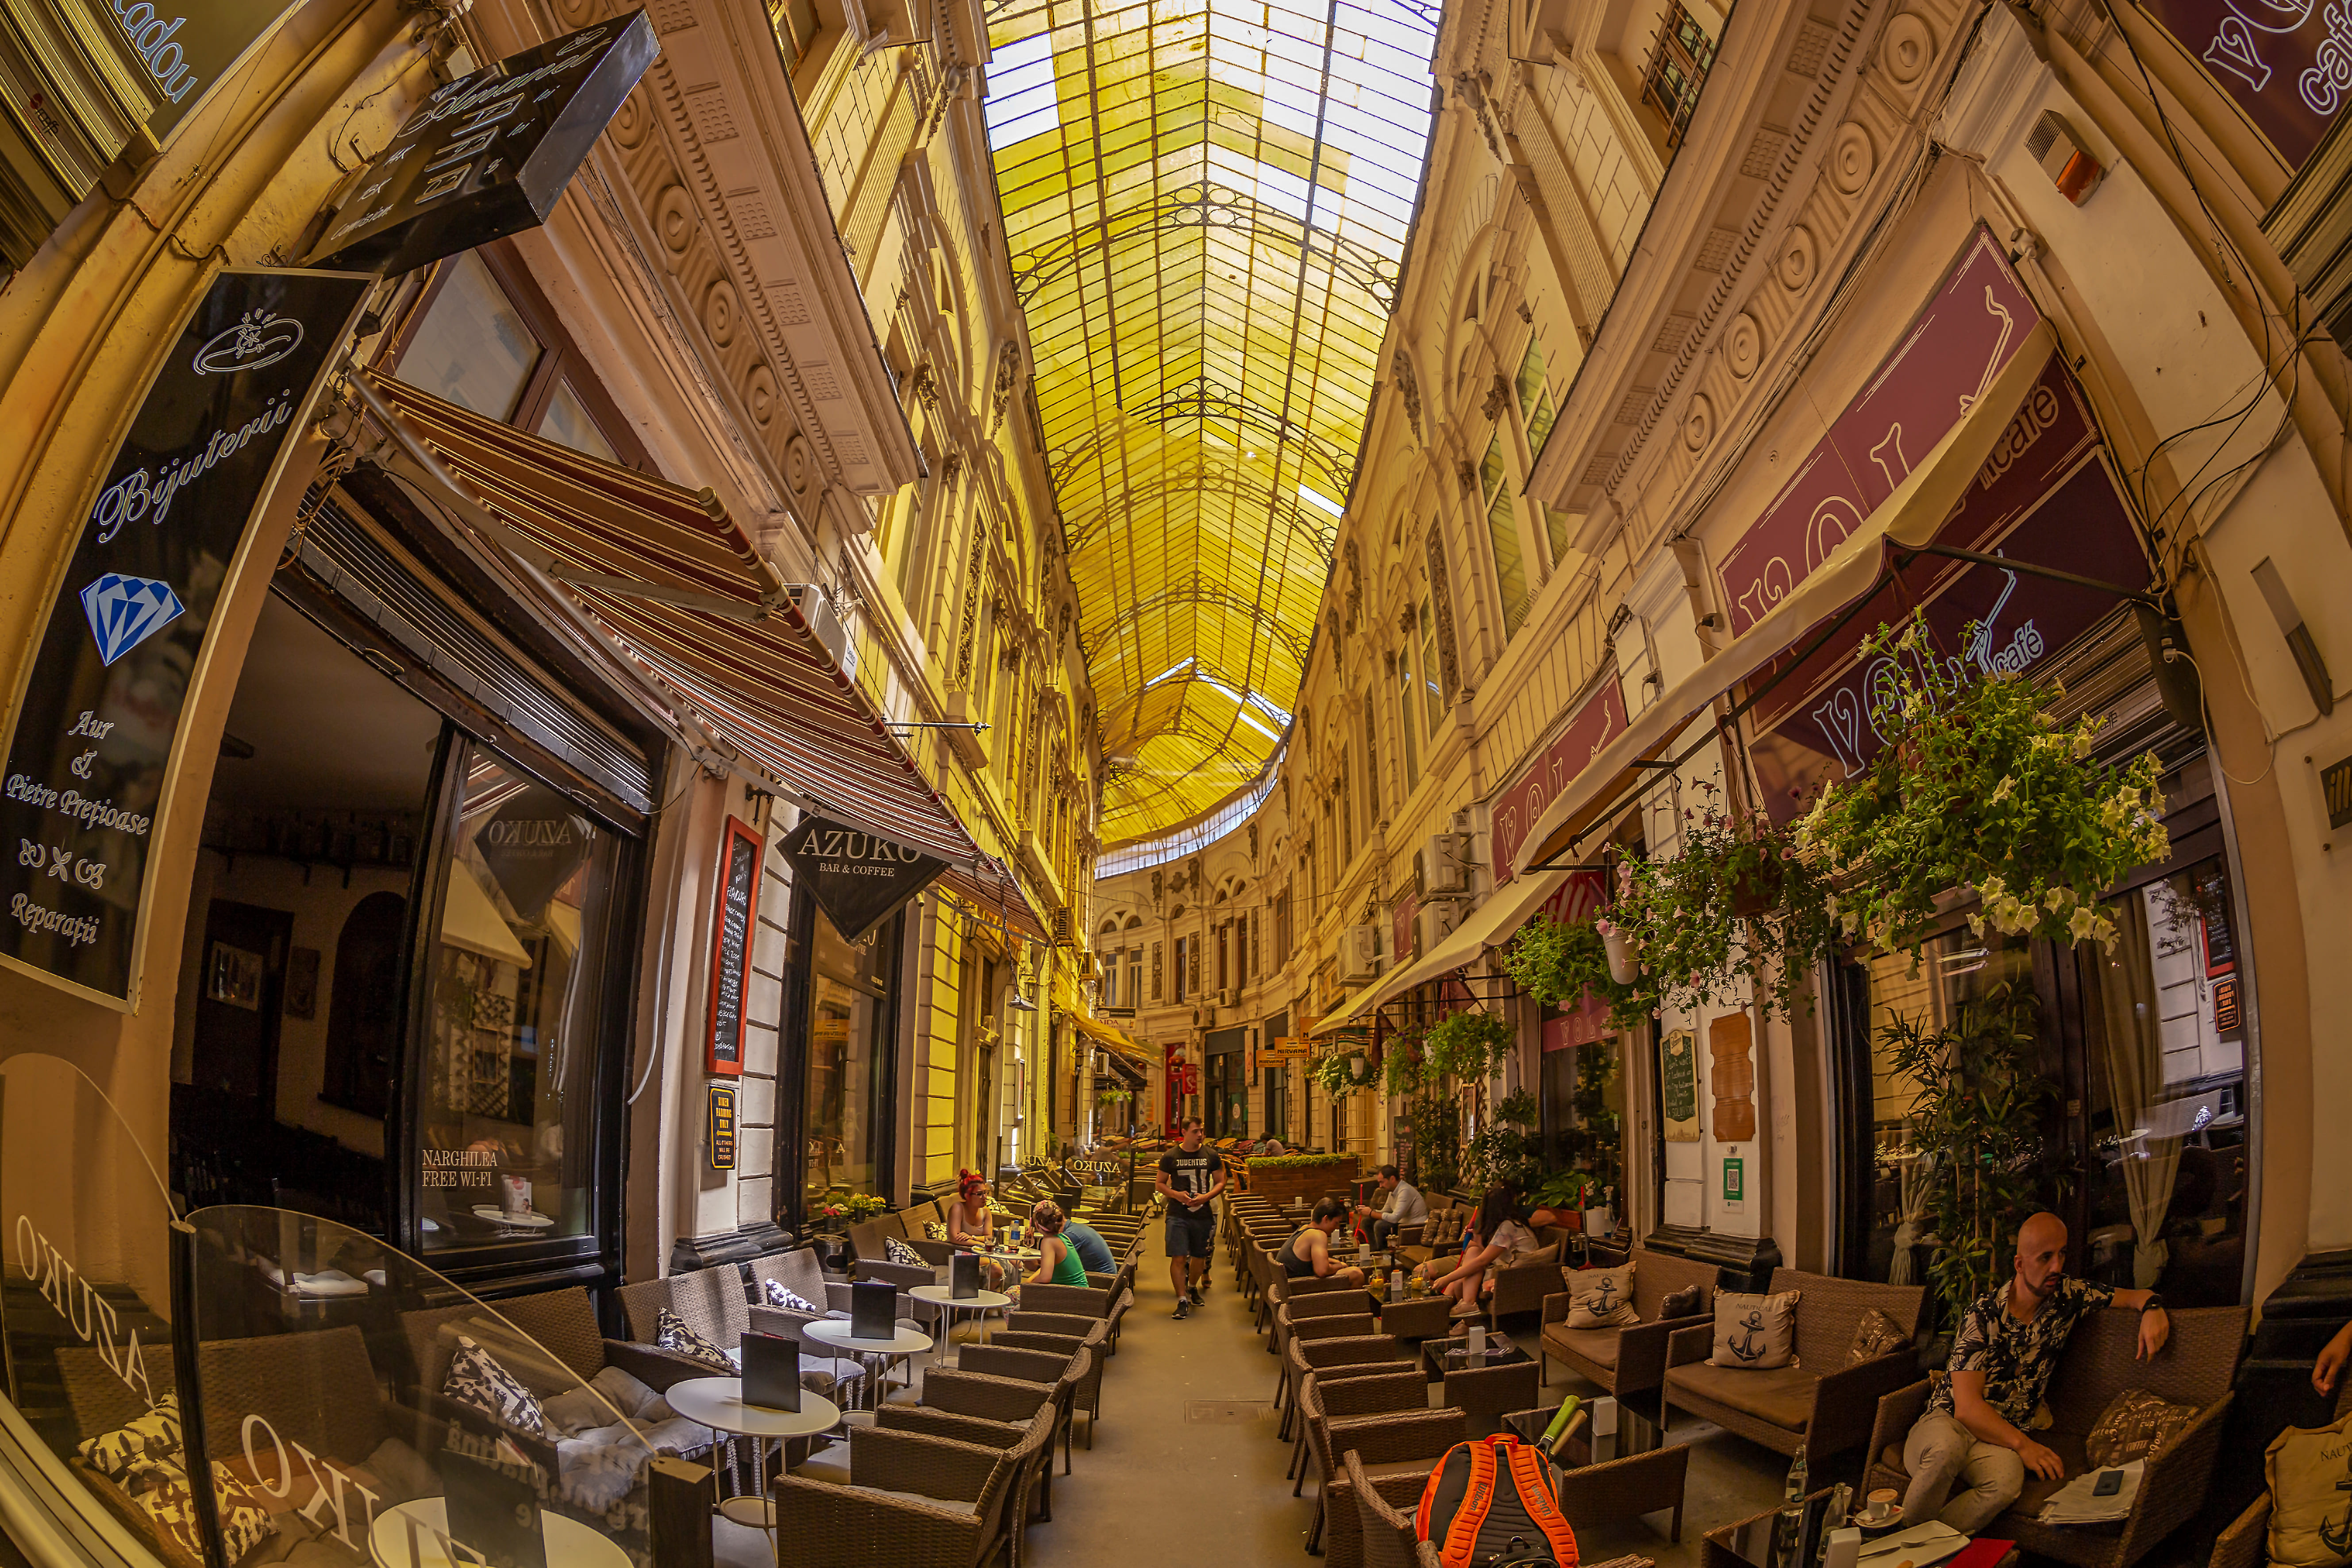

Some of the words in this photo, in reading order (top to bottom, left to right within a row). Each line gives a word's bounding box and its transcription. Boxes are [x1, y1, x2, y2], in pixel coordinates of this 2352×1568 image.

[115, 0, 198, 104] adou
[93, 389, 293, 544] Bijuterii
[68, 710, 115, 740] Aur
[7, 774, 58, 809] Pietre
[797, 828, 921, 863] AZUKO
[819, 863, 840, 872] BAR
[842, 864, 850, 874] &
[853, 865, 895, 877] COFFEE
[716, 1107, 731, 1118] PARKING
[719, 1119, 729, 1129] ONLY
[422, 1149, 498, 1167] NARGHILEA
[422, 1171, 457, 1187] FREE
[460, 1171, 492, 1187] WI-FI
[1735, 1302, 1774, 1313] NAUTICAL
[1470, 1483, 1488, 1511] Wilson
[1531, 1484, 1552, 1517] Wilson
